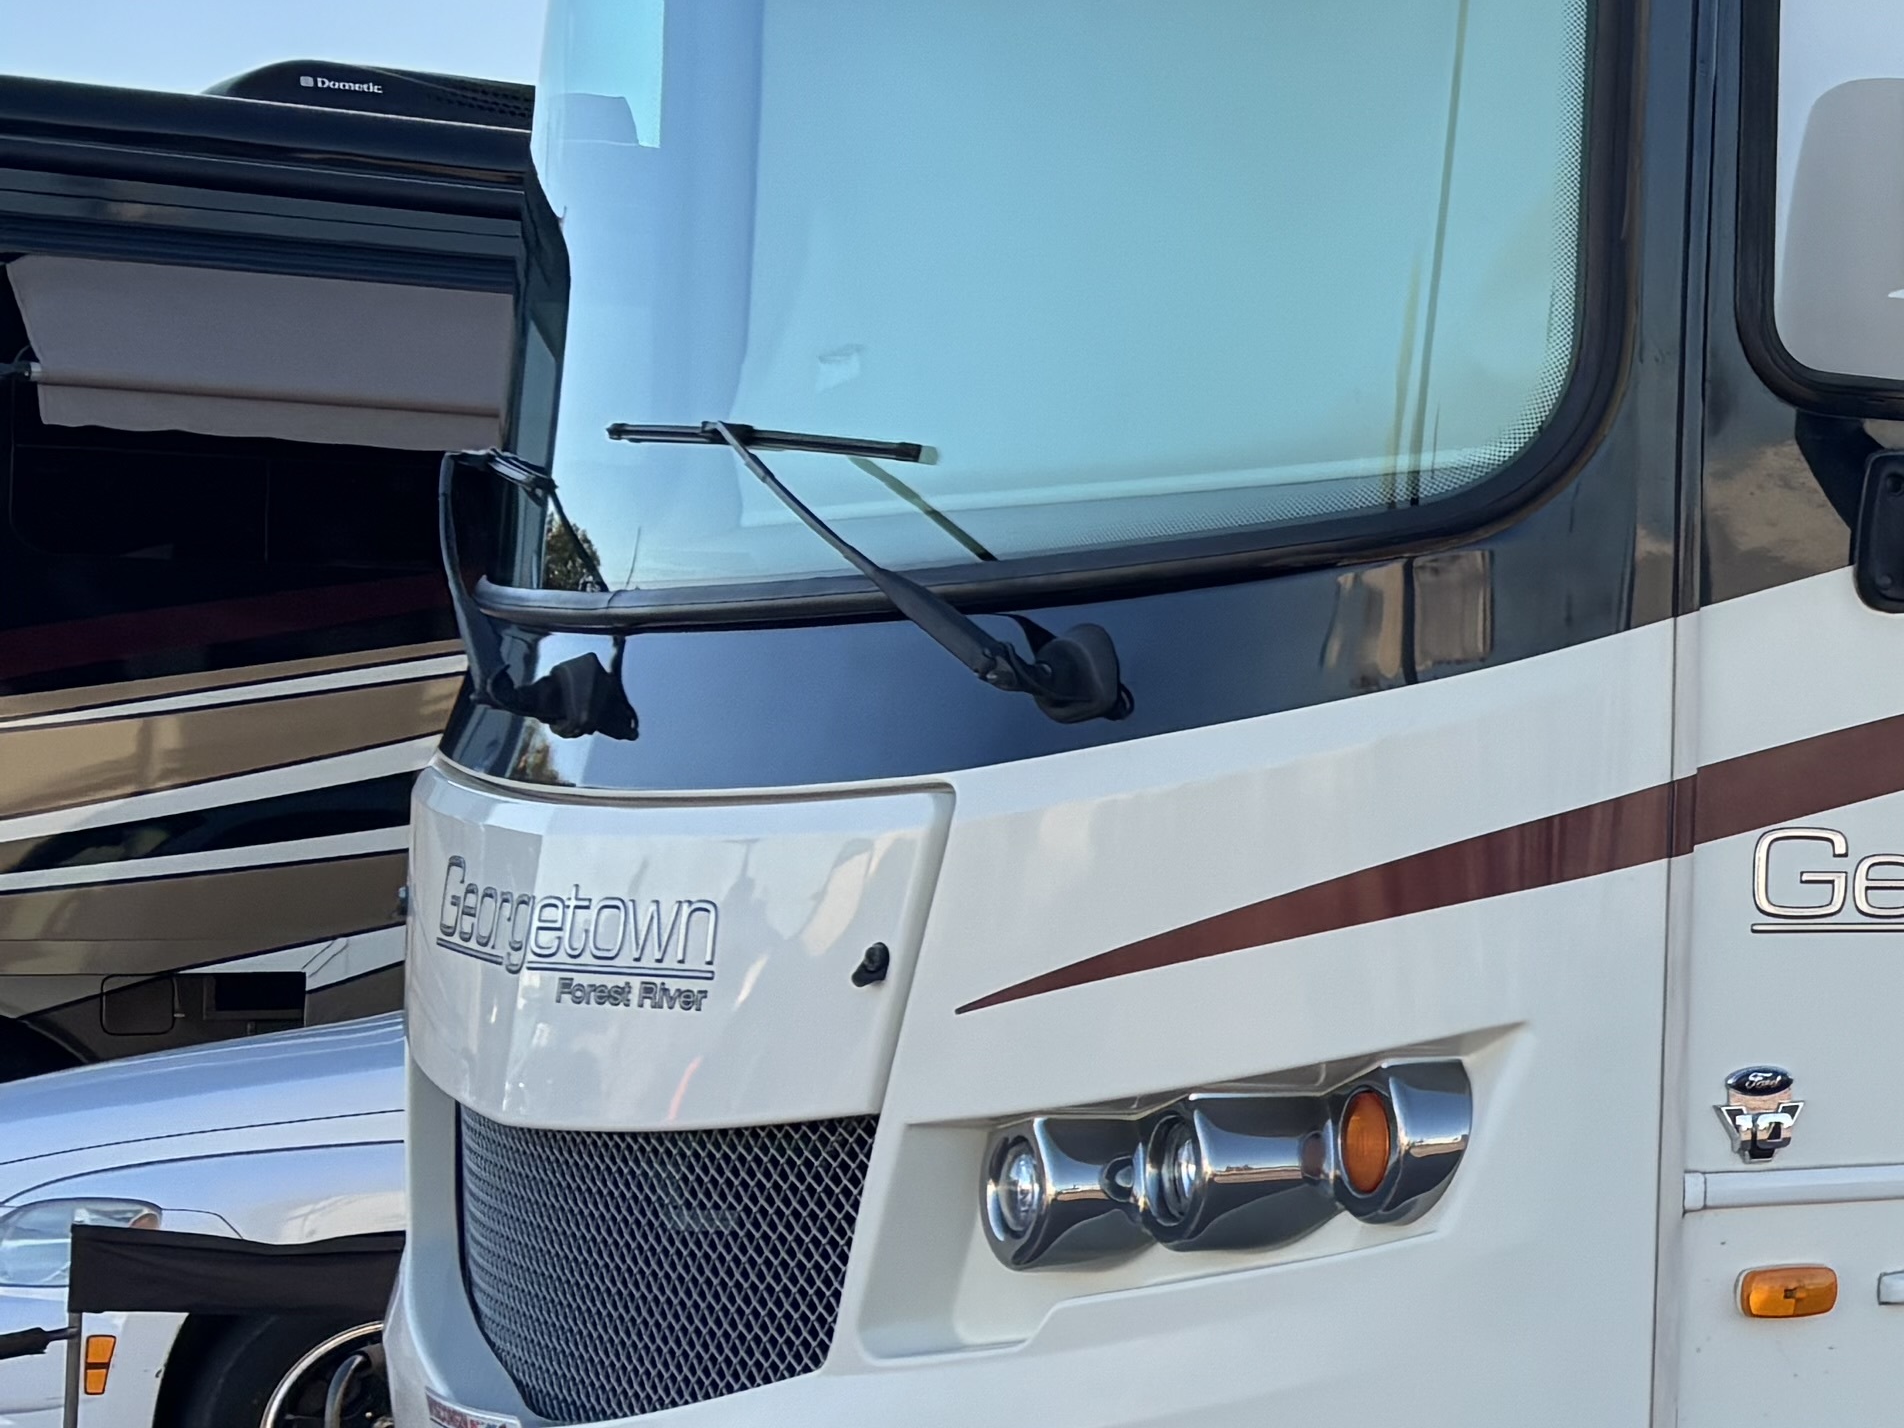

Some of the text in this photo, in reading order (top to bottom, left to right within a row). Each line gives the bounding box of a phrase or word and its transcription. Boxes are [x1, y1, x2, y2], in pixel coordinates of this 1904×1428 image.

[317, 77, 383, 93] Dometic
[439, 854, 718, 974] Georgetown
[555, 976, 708, 1011] Forest River
[1745, 1072, 1781, 1089] Ford
